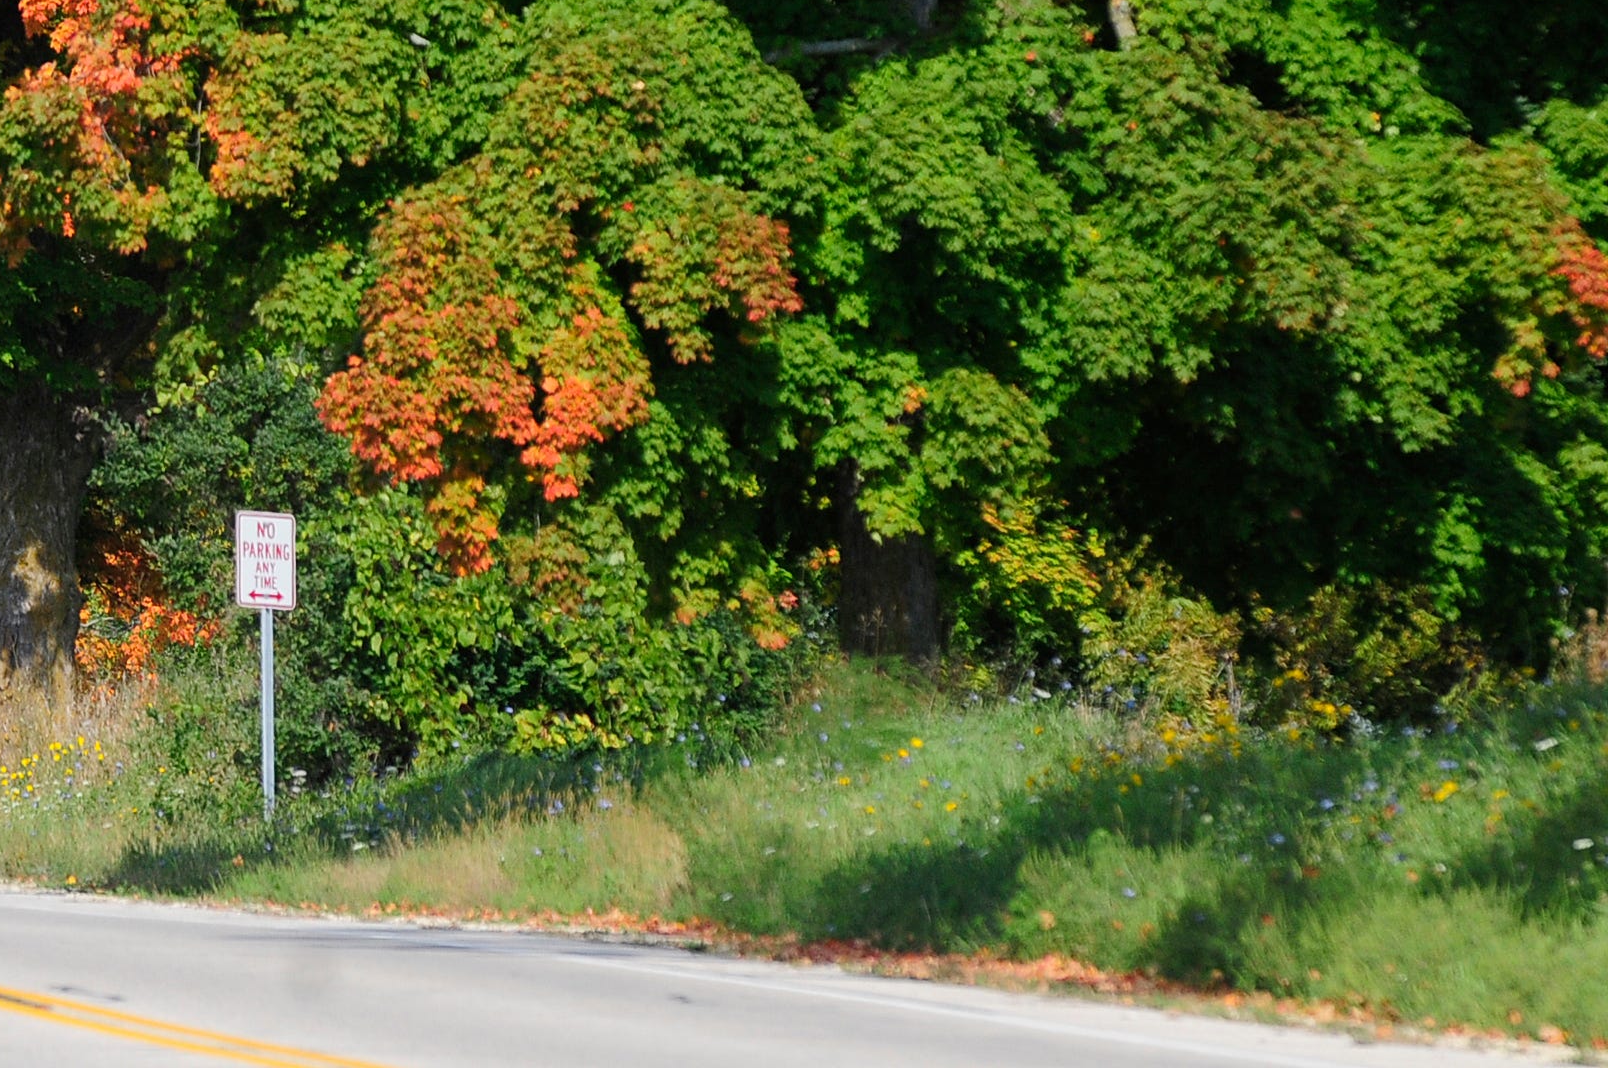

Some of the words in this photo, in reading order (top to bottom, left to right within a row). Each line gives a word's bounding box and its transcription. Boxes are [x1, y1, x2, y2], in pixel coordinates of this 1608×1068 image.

[257, 522, 275, 539] NO
[243, 541, 289, 560] PARKING
[256, 562, 276, 573] ANY
[254, 576, 277, 590] TIME
